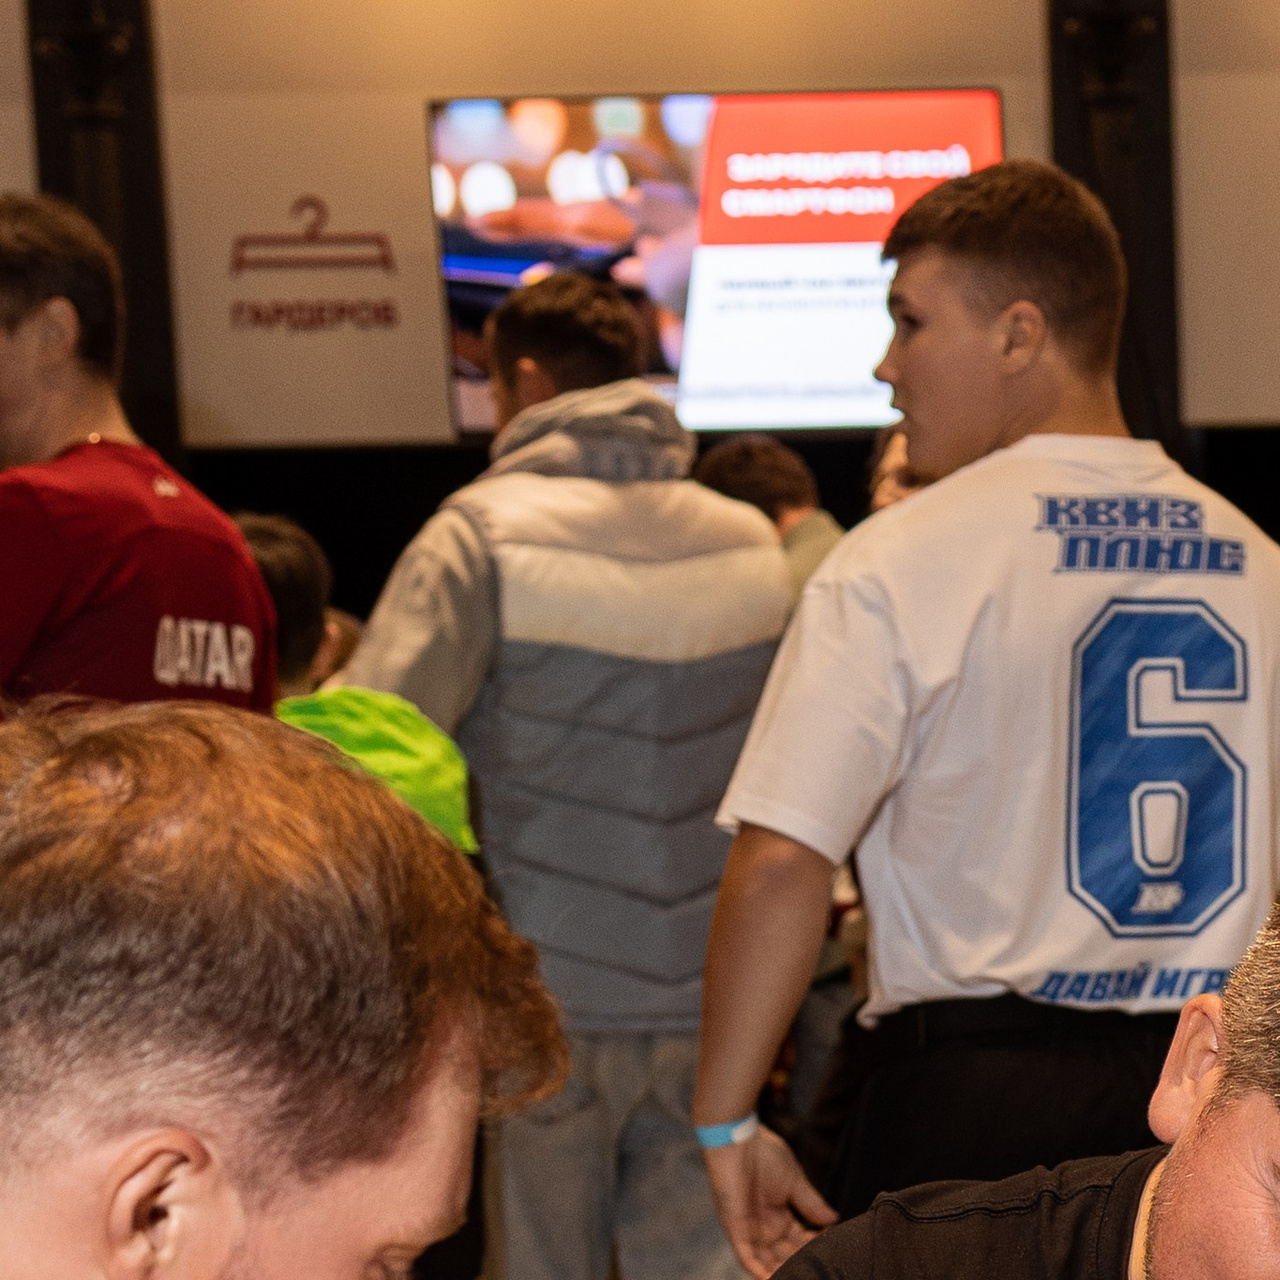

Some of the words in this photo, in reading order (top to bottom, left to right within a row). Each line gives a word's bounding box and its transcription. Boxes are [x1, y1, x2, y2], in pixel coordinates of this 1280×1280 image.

[230, 300, 400, 332] ГАРДЕРОБ
[1042, 496, 1203, 531] КВИЗ
[1060, 535, 1245, 573] ПЛЮС
[153, 613, 256, 693] QATAR
[1067, 597, 1248, 938] 6
